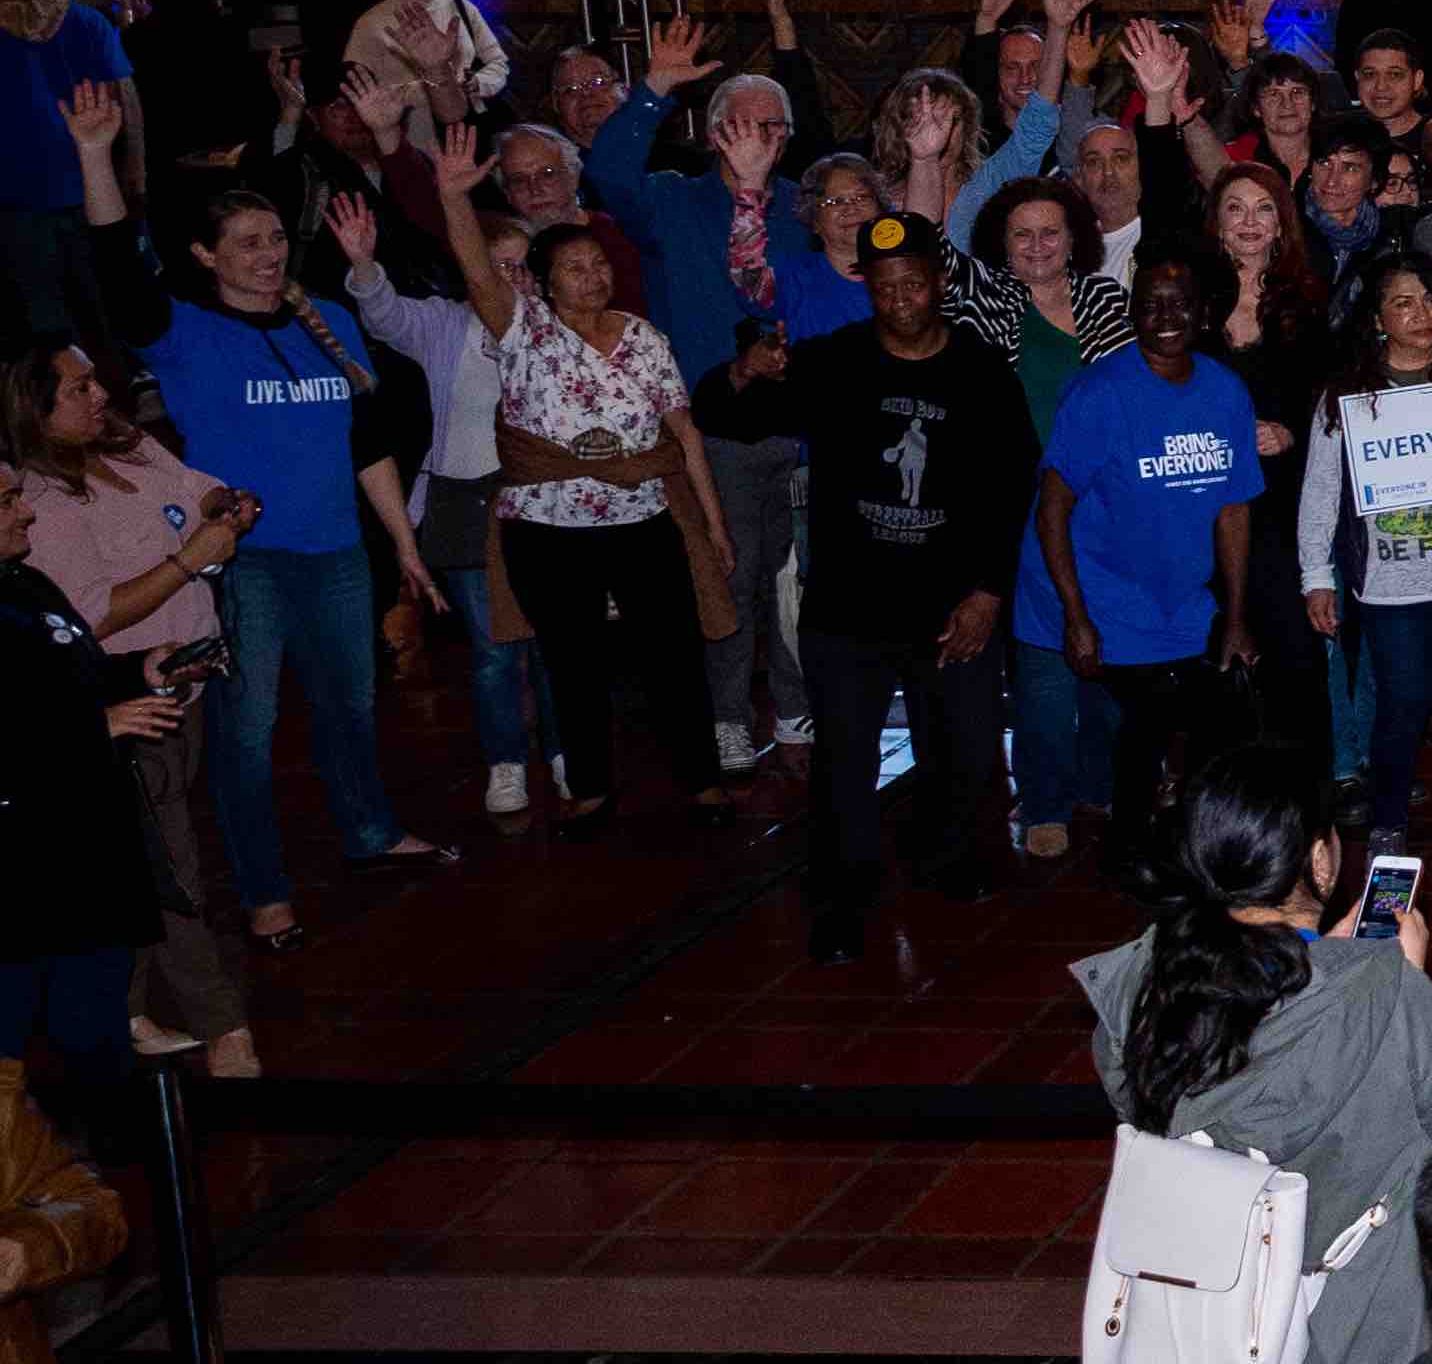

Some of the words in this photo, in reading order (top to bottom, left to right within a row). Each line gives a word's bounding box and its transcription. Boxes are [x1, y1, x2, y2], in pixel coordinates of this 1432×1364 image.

[246, 379, 286, 404] LIVE
[287, 376, 351, 404] UNITED
[1163, 432, 1219, 456] BRING
[1139, 450, 1228, 478] EVERYONE
[1377, 539, 1411, 561] BE
